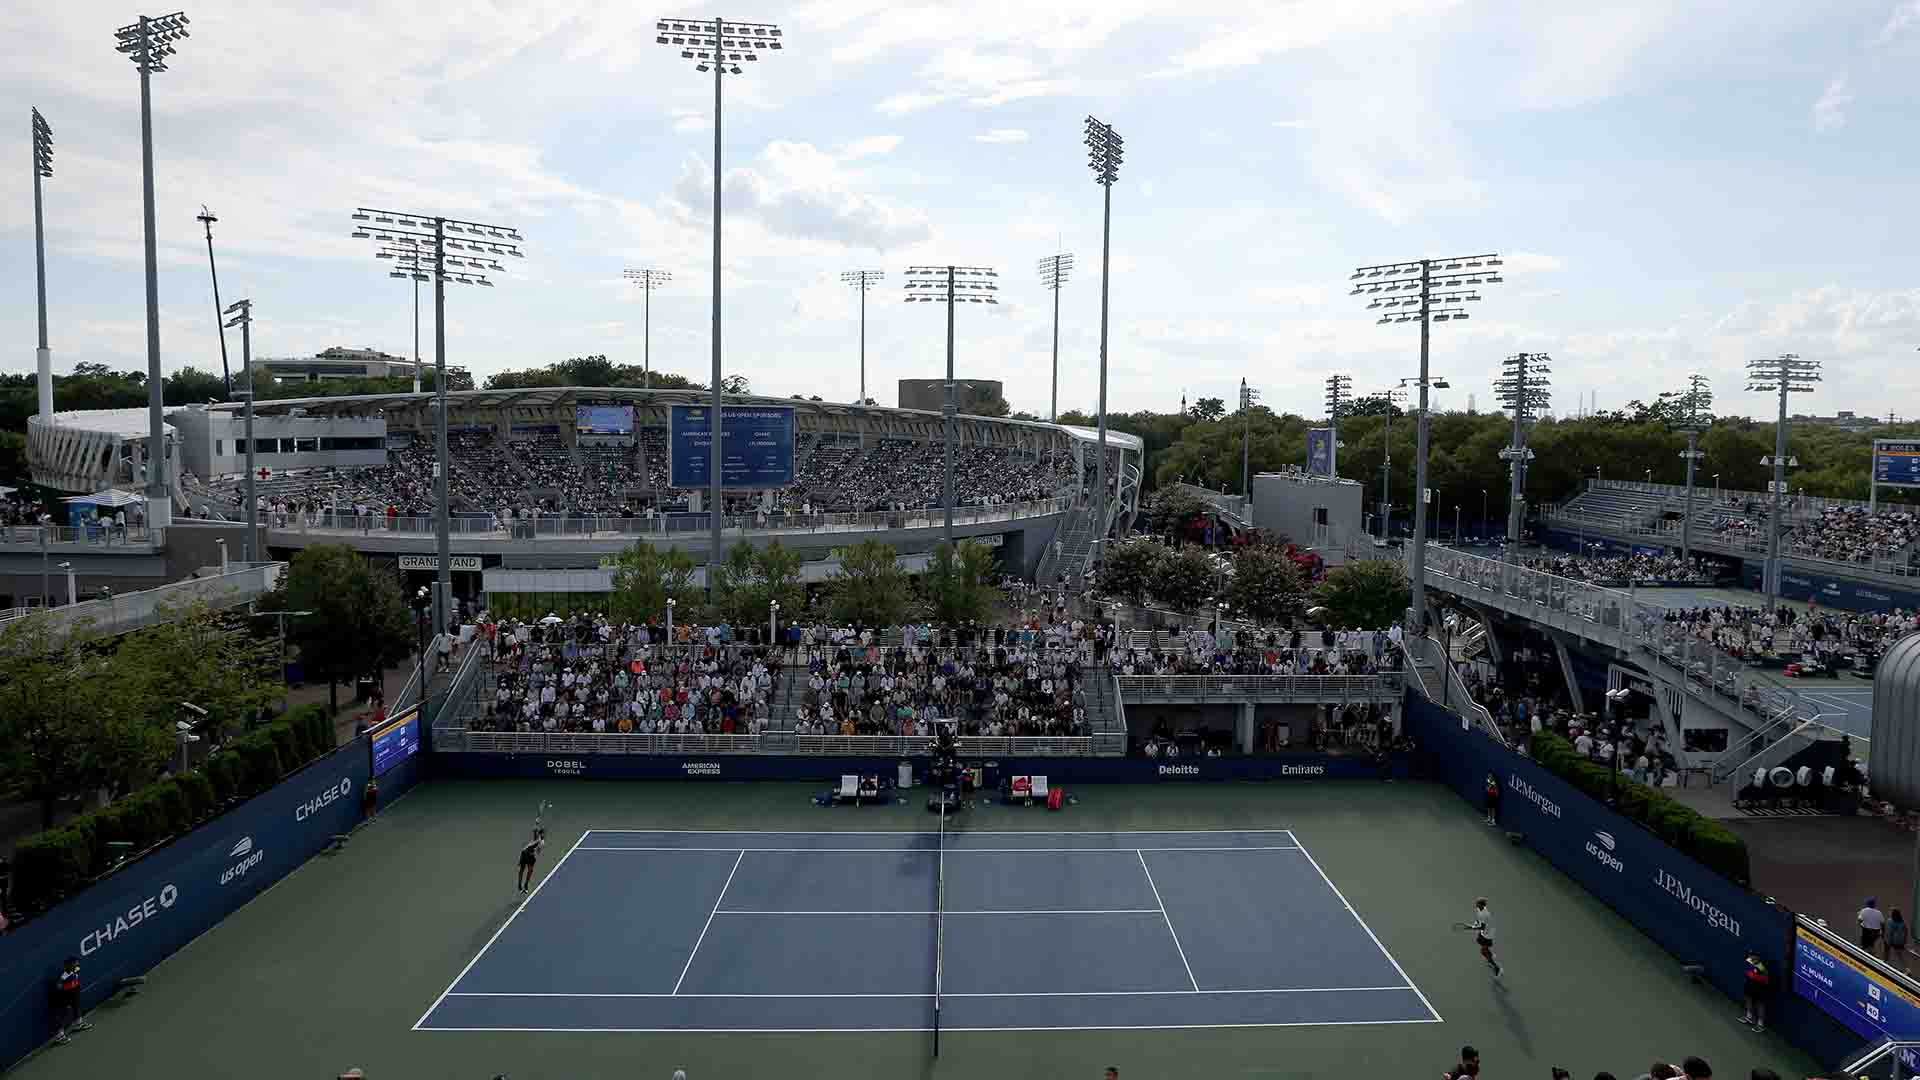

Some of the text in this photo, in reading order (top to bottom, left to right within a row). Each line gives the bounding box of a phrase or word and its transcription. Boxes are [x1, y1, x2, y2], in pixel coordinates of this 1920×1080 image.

[403, 557, 477, 568] GRANDTAND
[547, 760, 585, 768] DOBEL
[1159, 765, 1200, 774] Deloitte
[1281, 765, 1324, 774] Emirates
[295, 785, 340, 821] CHASE
[235, 849, 264, 877] open
[1598, 851, 1624, 873] open
[79, 896, 158, 956] CHASE
[1810, 950, 1835, 969] DIALLO
[1808, 967, 1833, 988] MUNAR
